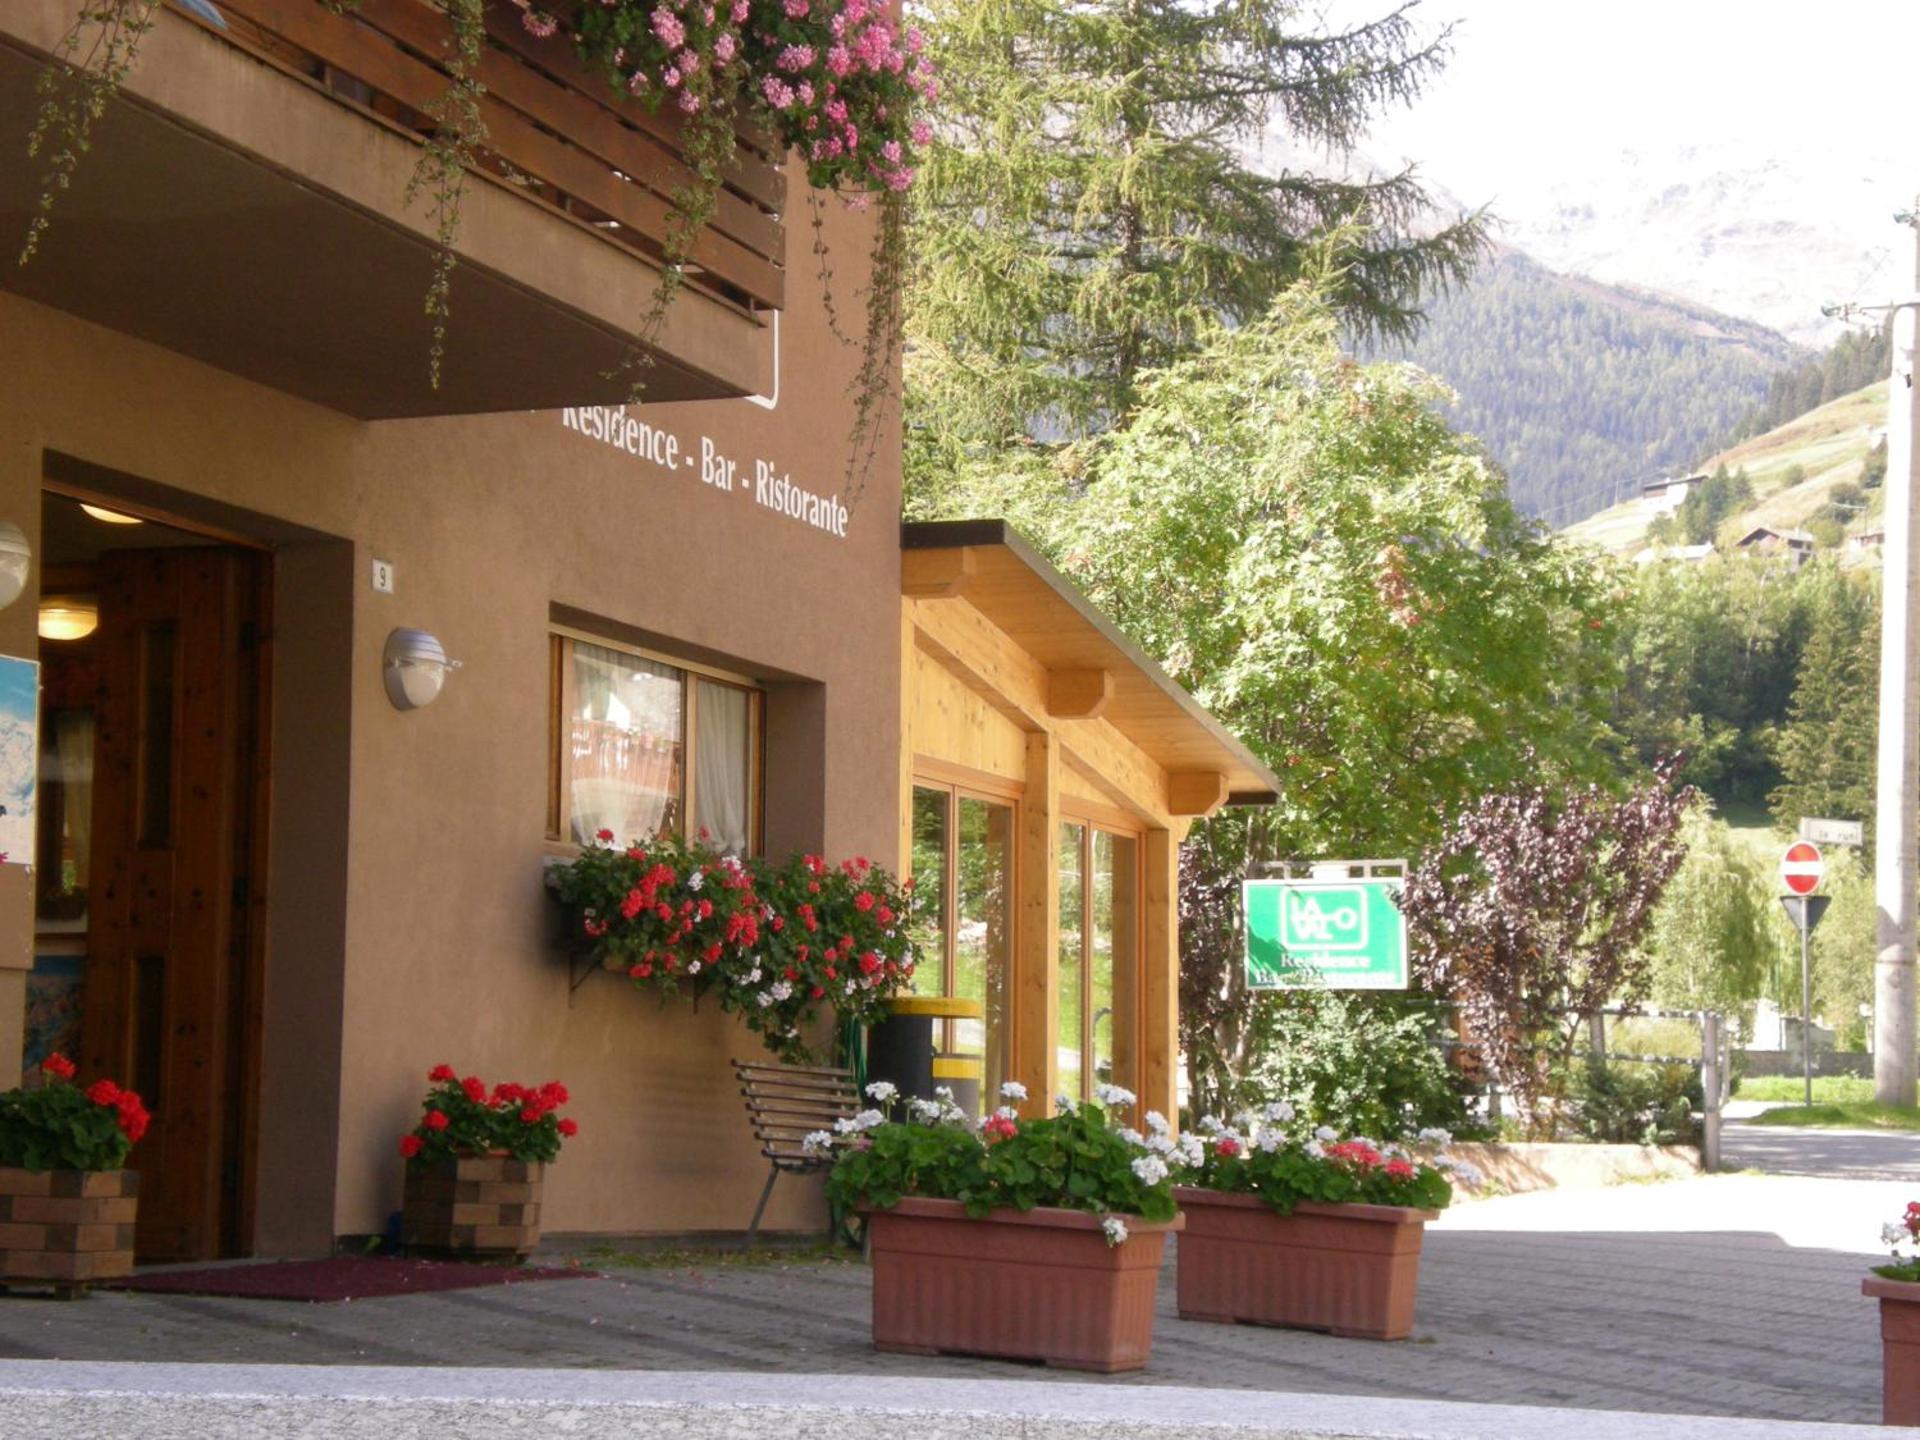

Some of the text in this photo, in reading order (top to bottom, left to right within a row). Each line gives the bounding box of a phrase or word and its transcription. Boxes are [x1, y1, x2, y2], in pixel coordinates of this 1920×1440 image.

[701, 436, 736, 491] Bar
[756, 458, 849, 538] Ristorante
[379, 566, 386, 587] 9
